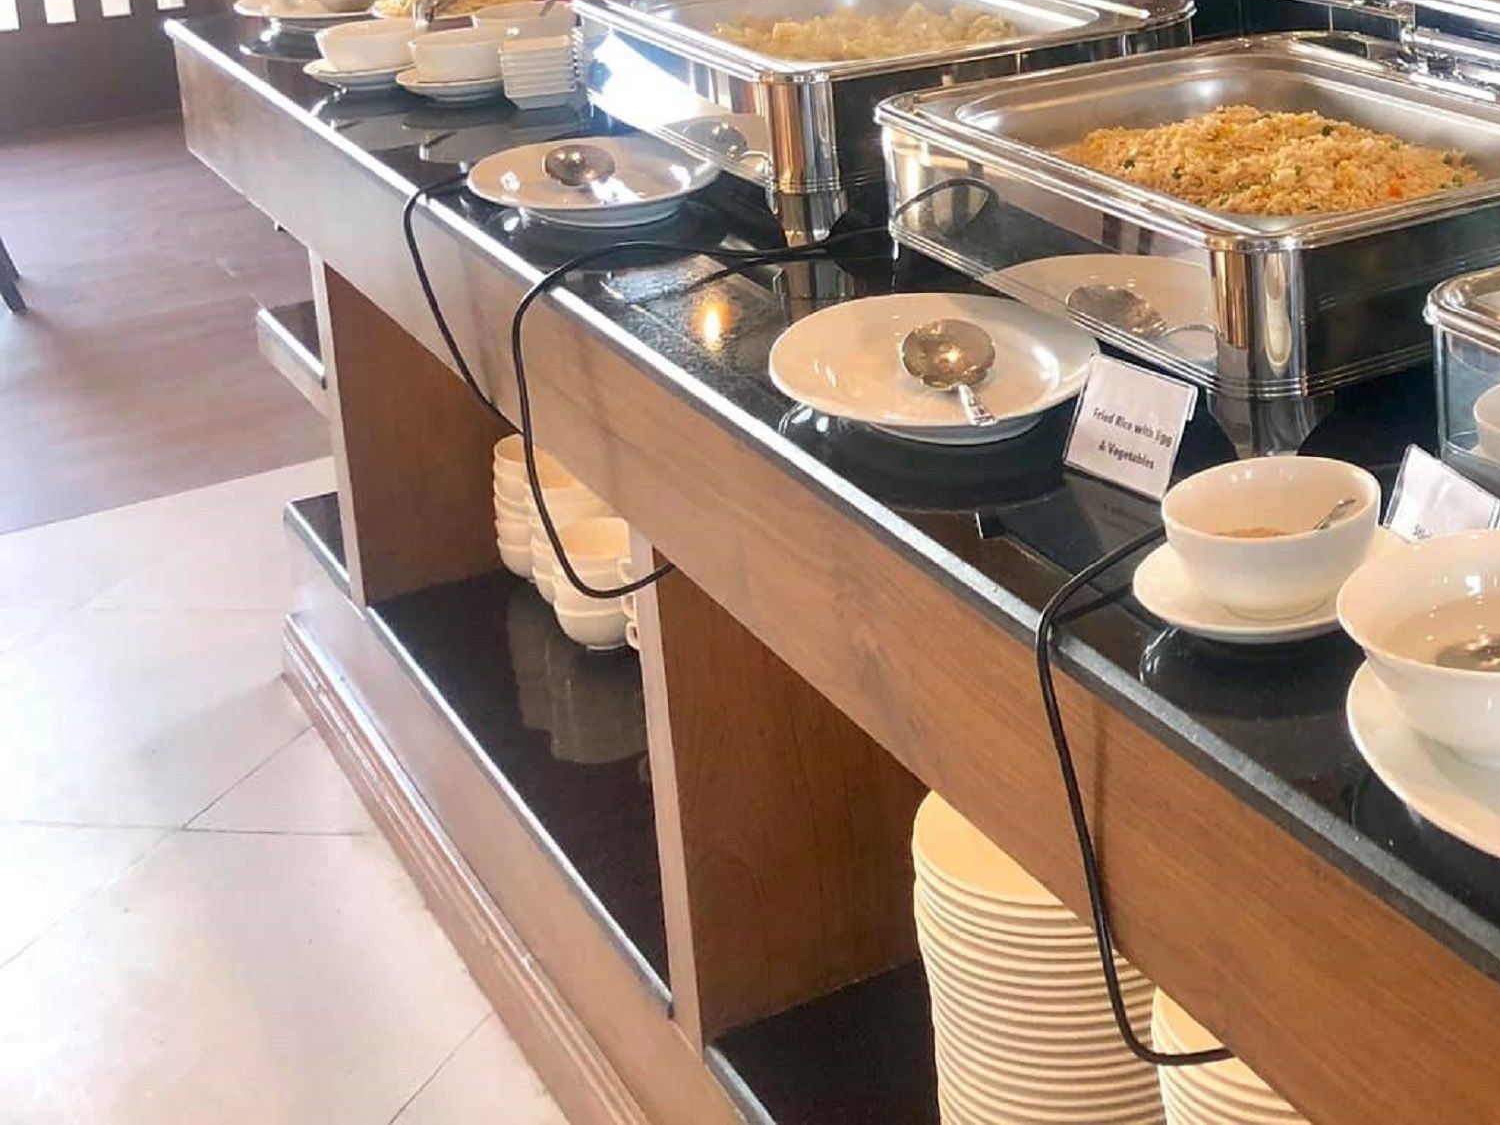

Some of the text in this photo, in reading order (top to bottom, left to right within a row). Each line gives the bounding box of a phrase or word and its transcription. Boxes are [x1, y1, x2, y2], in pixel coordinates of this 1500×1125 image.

[1093, 408, 1173, 448] Fried Rice with Egg
[1108, 442, 1155, 470] Vegetables
